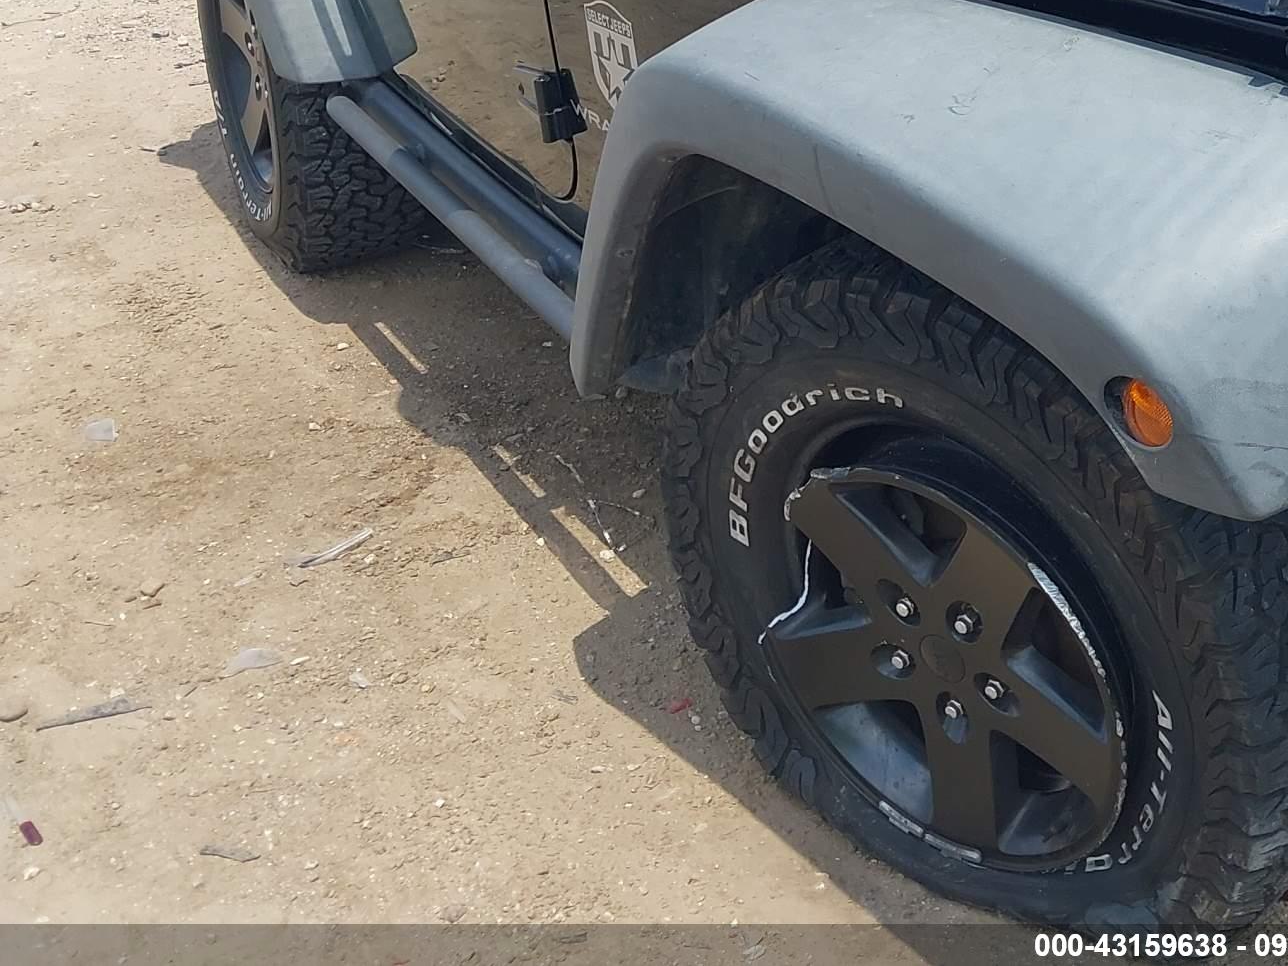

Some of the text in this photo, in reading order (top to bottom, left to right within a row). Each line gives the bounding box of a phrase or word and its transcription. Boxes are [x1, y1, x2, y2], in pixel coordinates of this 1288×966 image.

[586, 8, 631, 37] SELECT JEEPS
[729, 384, 903, 547] BFGoodrich
